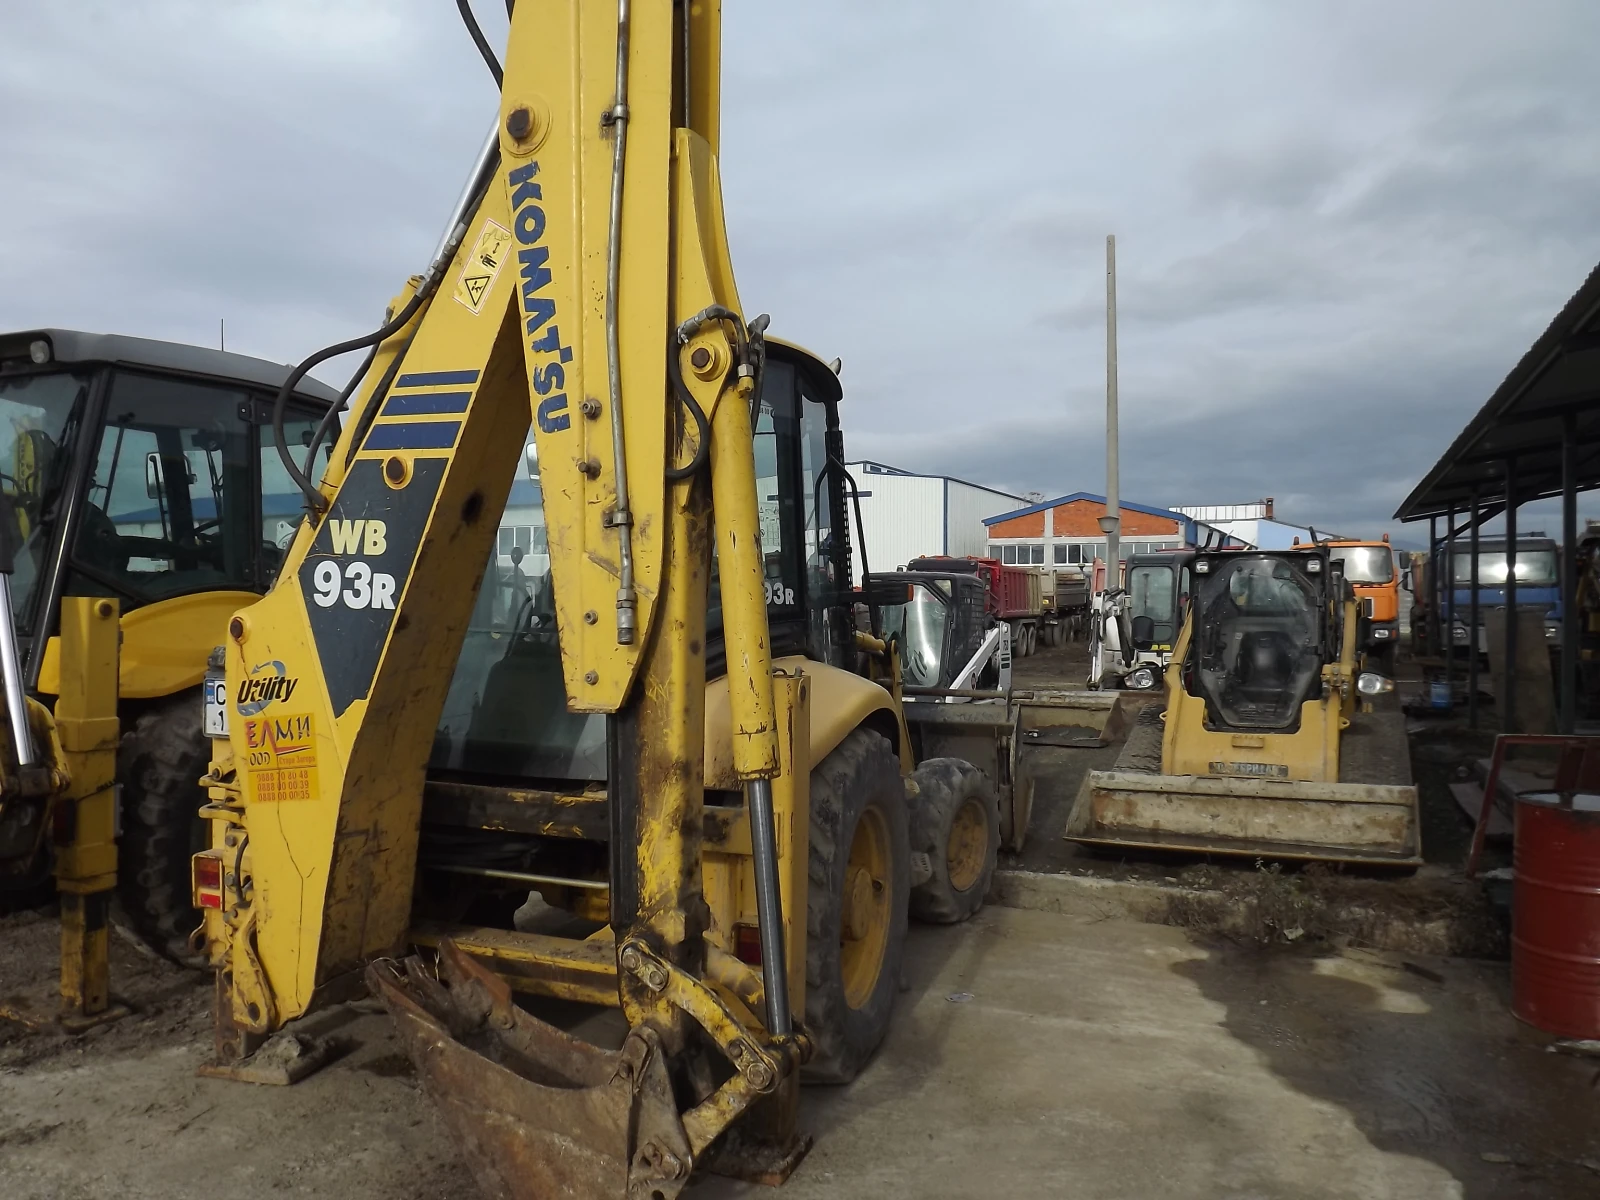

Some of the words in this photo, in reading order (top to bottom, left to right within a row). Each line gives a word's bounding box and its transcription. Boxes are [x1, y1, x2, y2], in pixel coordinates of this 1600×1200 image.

[508, 160, 573, 434] KOMATSU
[329, 519, 387, 556] WB
[313, 560, 396, 610] 93R
[236, 675, 299, 704] Utility
